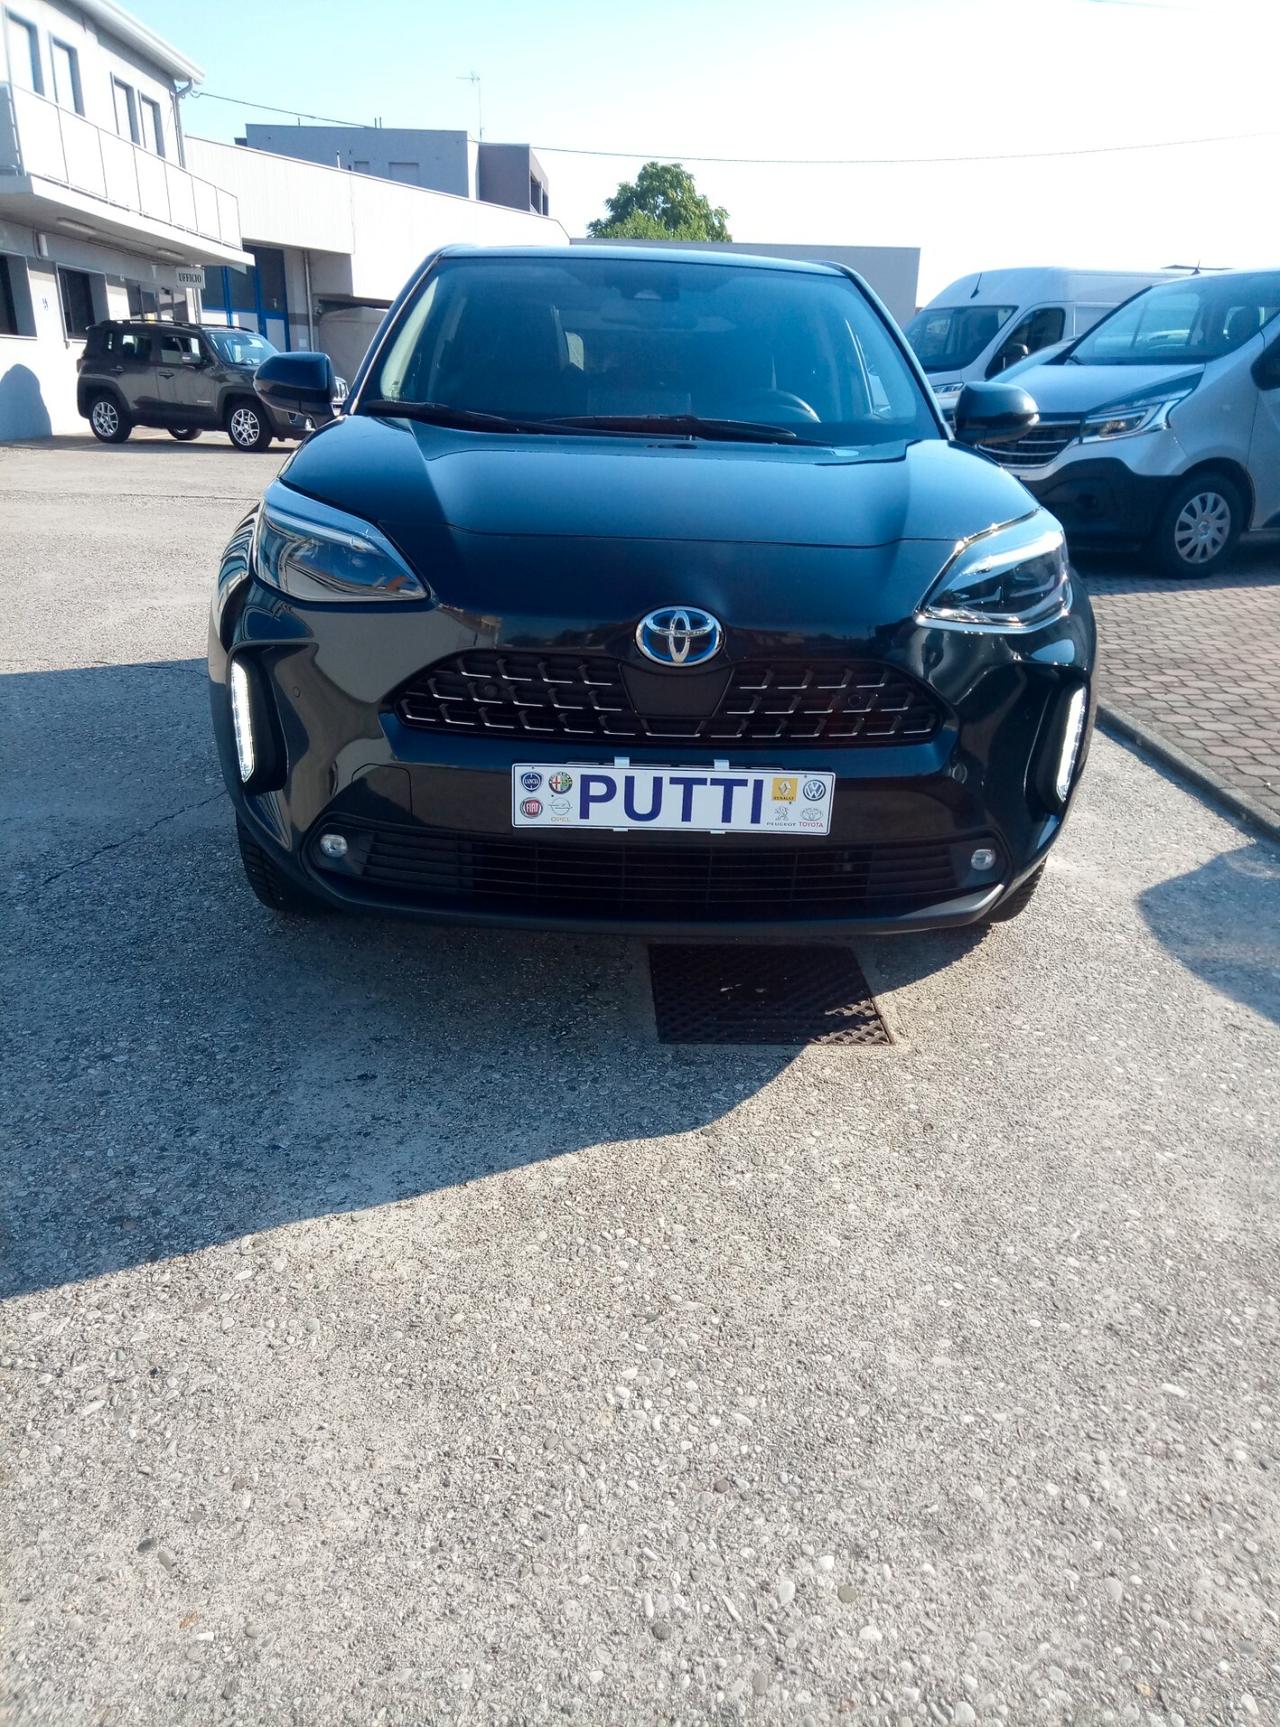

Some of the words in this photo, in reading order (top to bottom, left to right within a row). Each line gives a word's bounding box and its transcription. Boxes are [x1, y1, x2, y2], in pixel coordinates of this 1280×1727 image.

[179, 272, 202, 283] UFFICIO
[579, 773, 764, 824] PUTTI
[526, 803, 539, 813] FIAT
